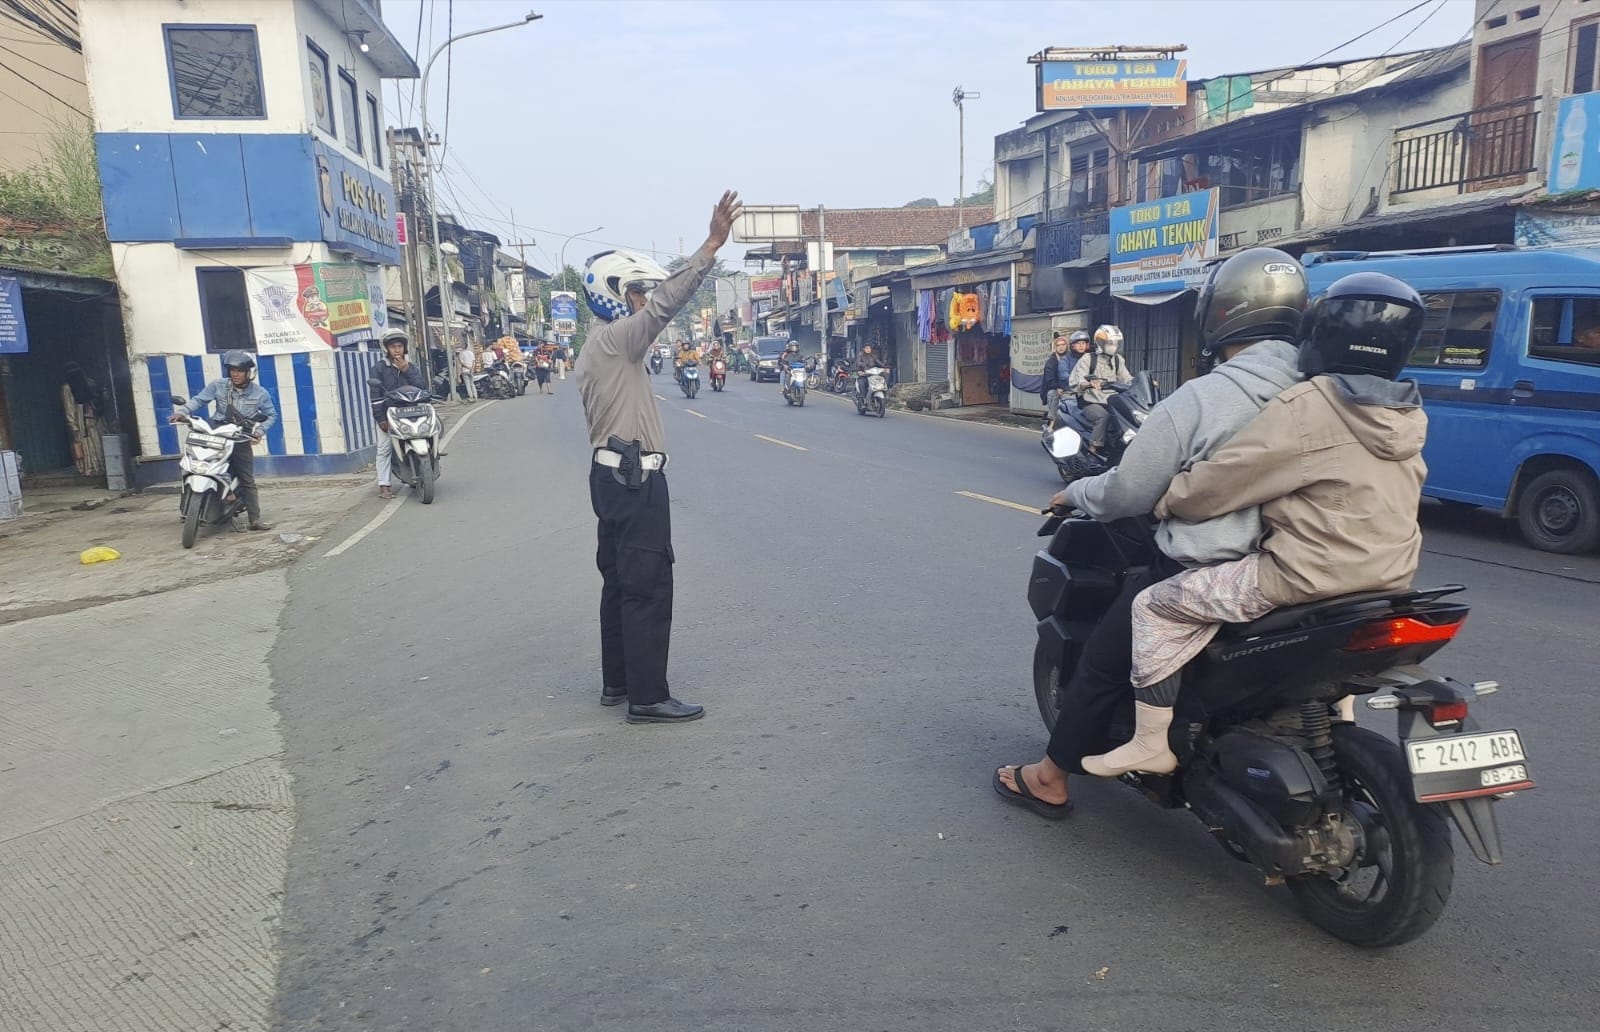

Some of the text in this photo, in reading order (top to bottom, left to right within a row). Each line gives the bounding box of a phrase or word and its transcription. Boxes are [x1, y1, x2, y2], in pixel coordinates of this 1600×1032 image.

[1075, 64, 1117, 76] TOKO
[1054, 77, 1178, 91] CAHAYA TEKNIK
[340, 170, 388, 220] POS 14 B
[1130, 205, 1160, 225] TOKO
[1116, 219, 1207, 254] CAHAYA TEKNIK
[1142, 256, 1175, 268] MENJUAL
[1112, 273, 1143, 285] PERLENGKAPAN
[1143, 271, 1161, 281] LISTRIK
[1161, 270, 1171, 279] DAN
[1171, 267, 1201, 278] ELEKTRONIK
[259, 337, 283, 345] POLRES
[265, 331, 302, 339] SATLANTAS
[1349, 344, 1388, 355] HONDA
[1221, 640, 1285, 661] VARIO
[1414, 736, 1521, 769] F 2412 ABA
